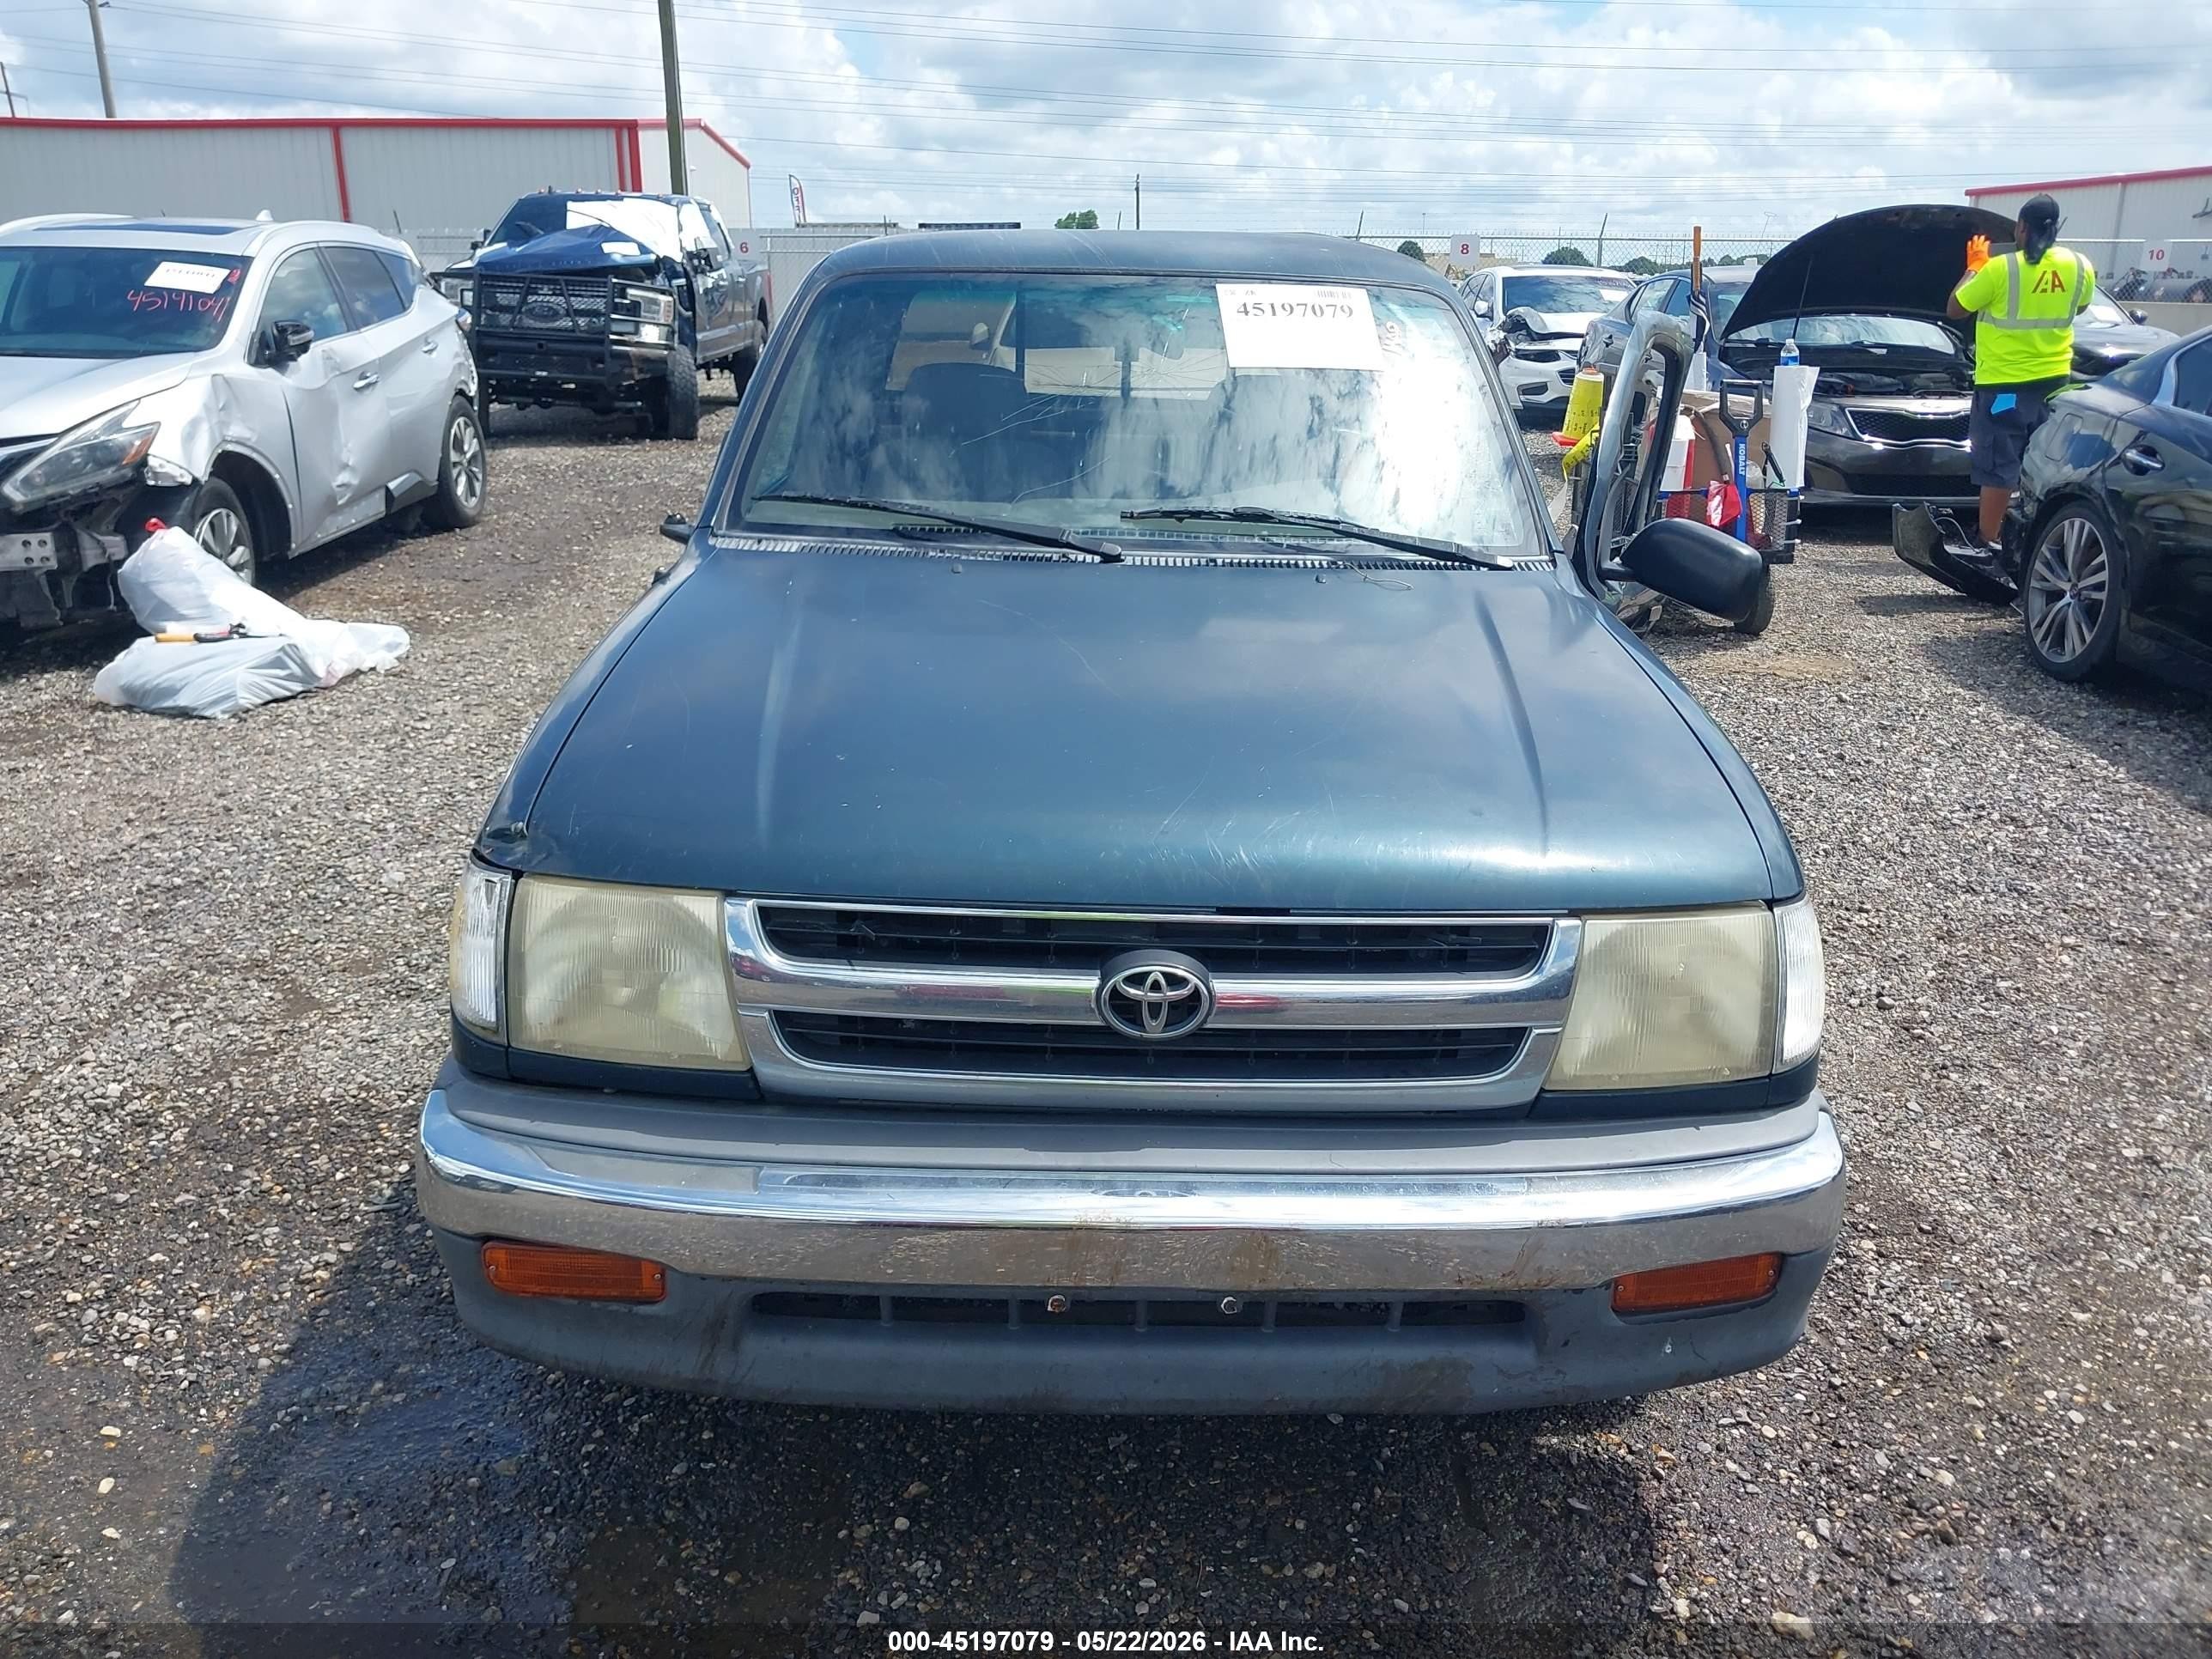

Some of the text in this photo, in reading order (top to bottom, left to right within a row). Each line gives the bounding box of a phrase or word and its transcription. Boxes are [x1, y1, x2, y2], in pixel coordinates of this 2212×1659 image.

[740, 242, 749, 253] 6
[1461, 244, 1469, 255] 8
[2148, 249, 2164, 260] 10
[1237, 302, 1353, 318] 45197079
